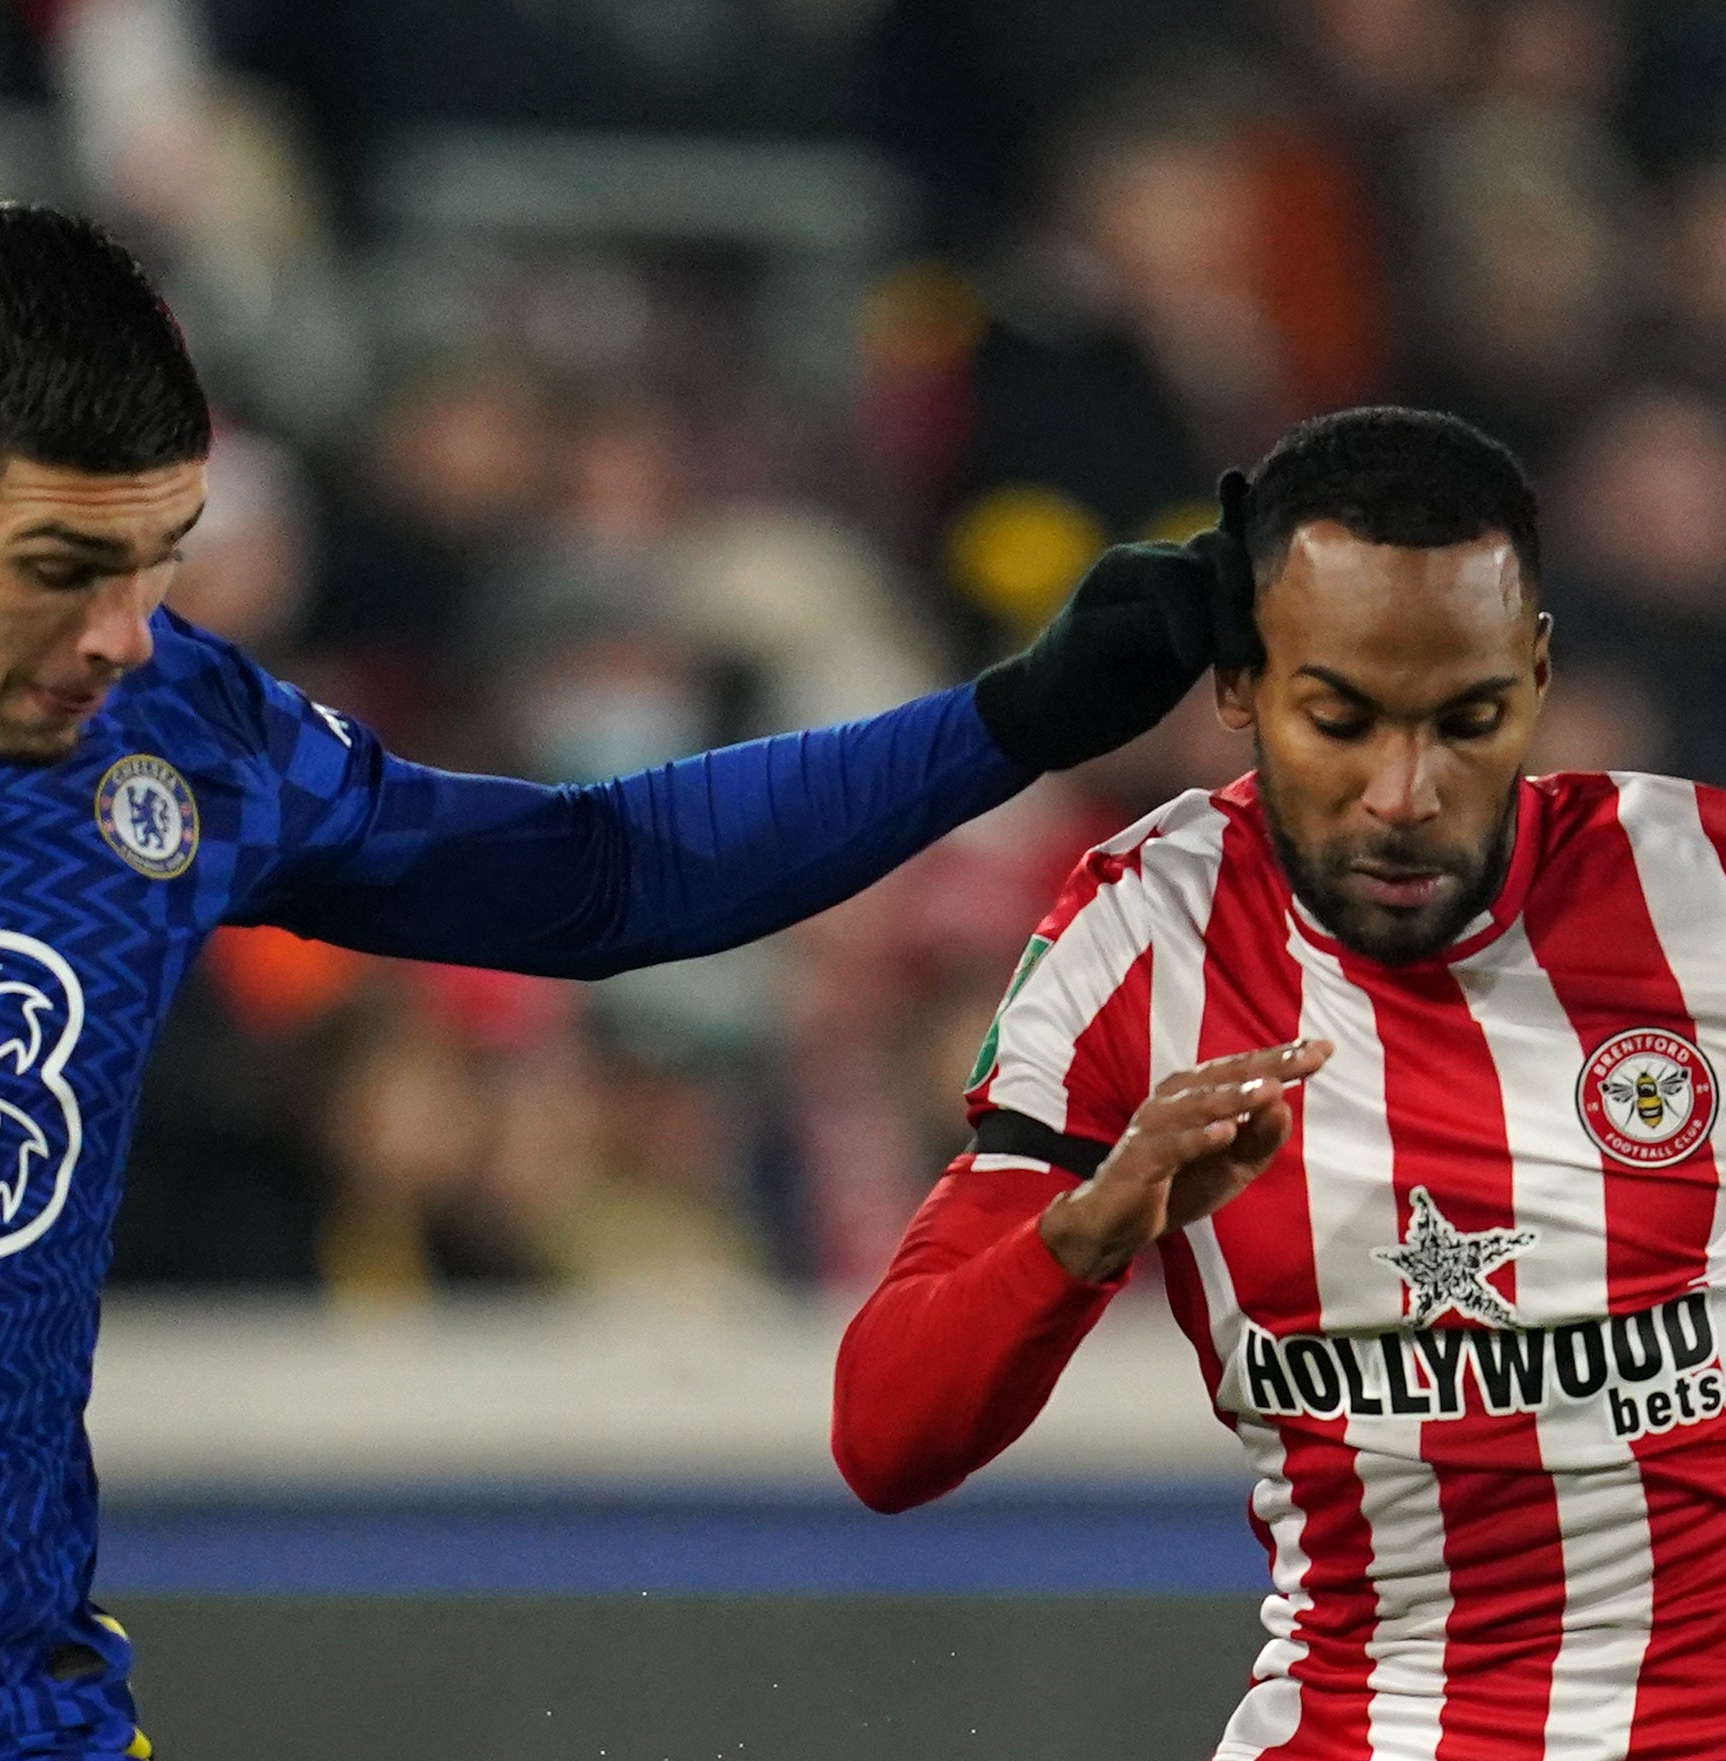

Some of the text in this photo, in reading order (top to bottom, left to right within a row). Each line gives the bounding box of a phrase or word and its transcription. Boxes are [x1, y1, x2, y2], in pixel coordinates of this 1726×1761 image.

[1593, 1036, 1691, 1077] BRENTFORD
[1605, 1119, 1703, 1159] FOOTBALL CLUB
[1245, 1292, 1719, 1417] HOLLYWOOD
[1607, 1372, 1723, 1437] bets
